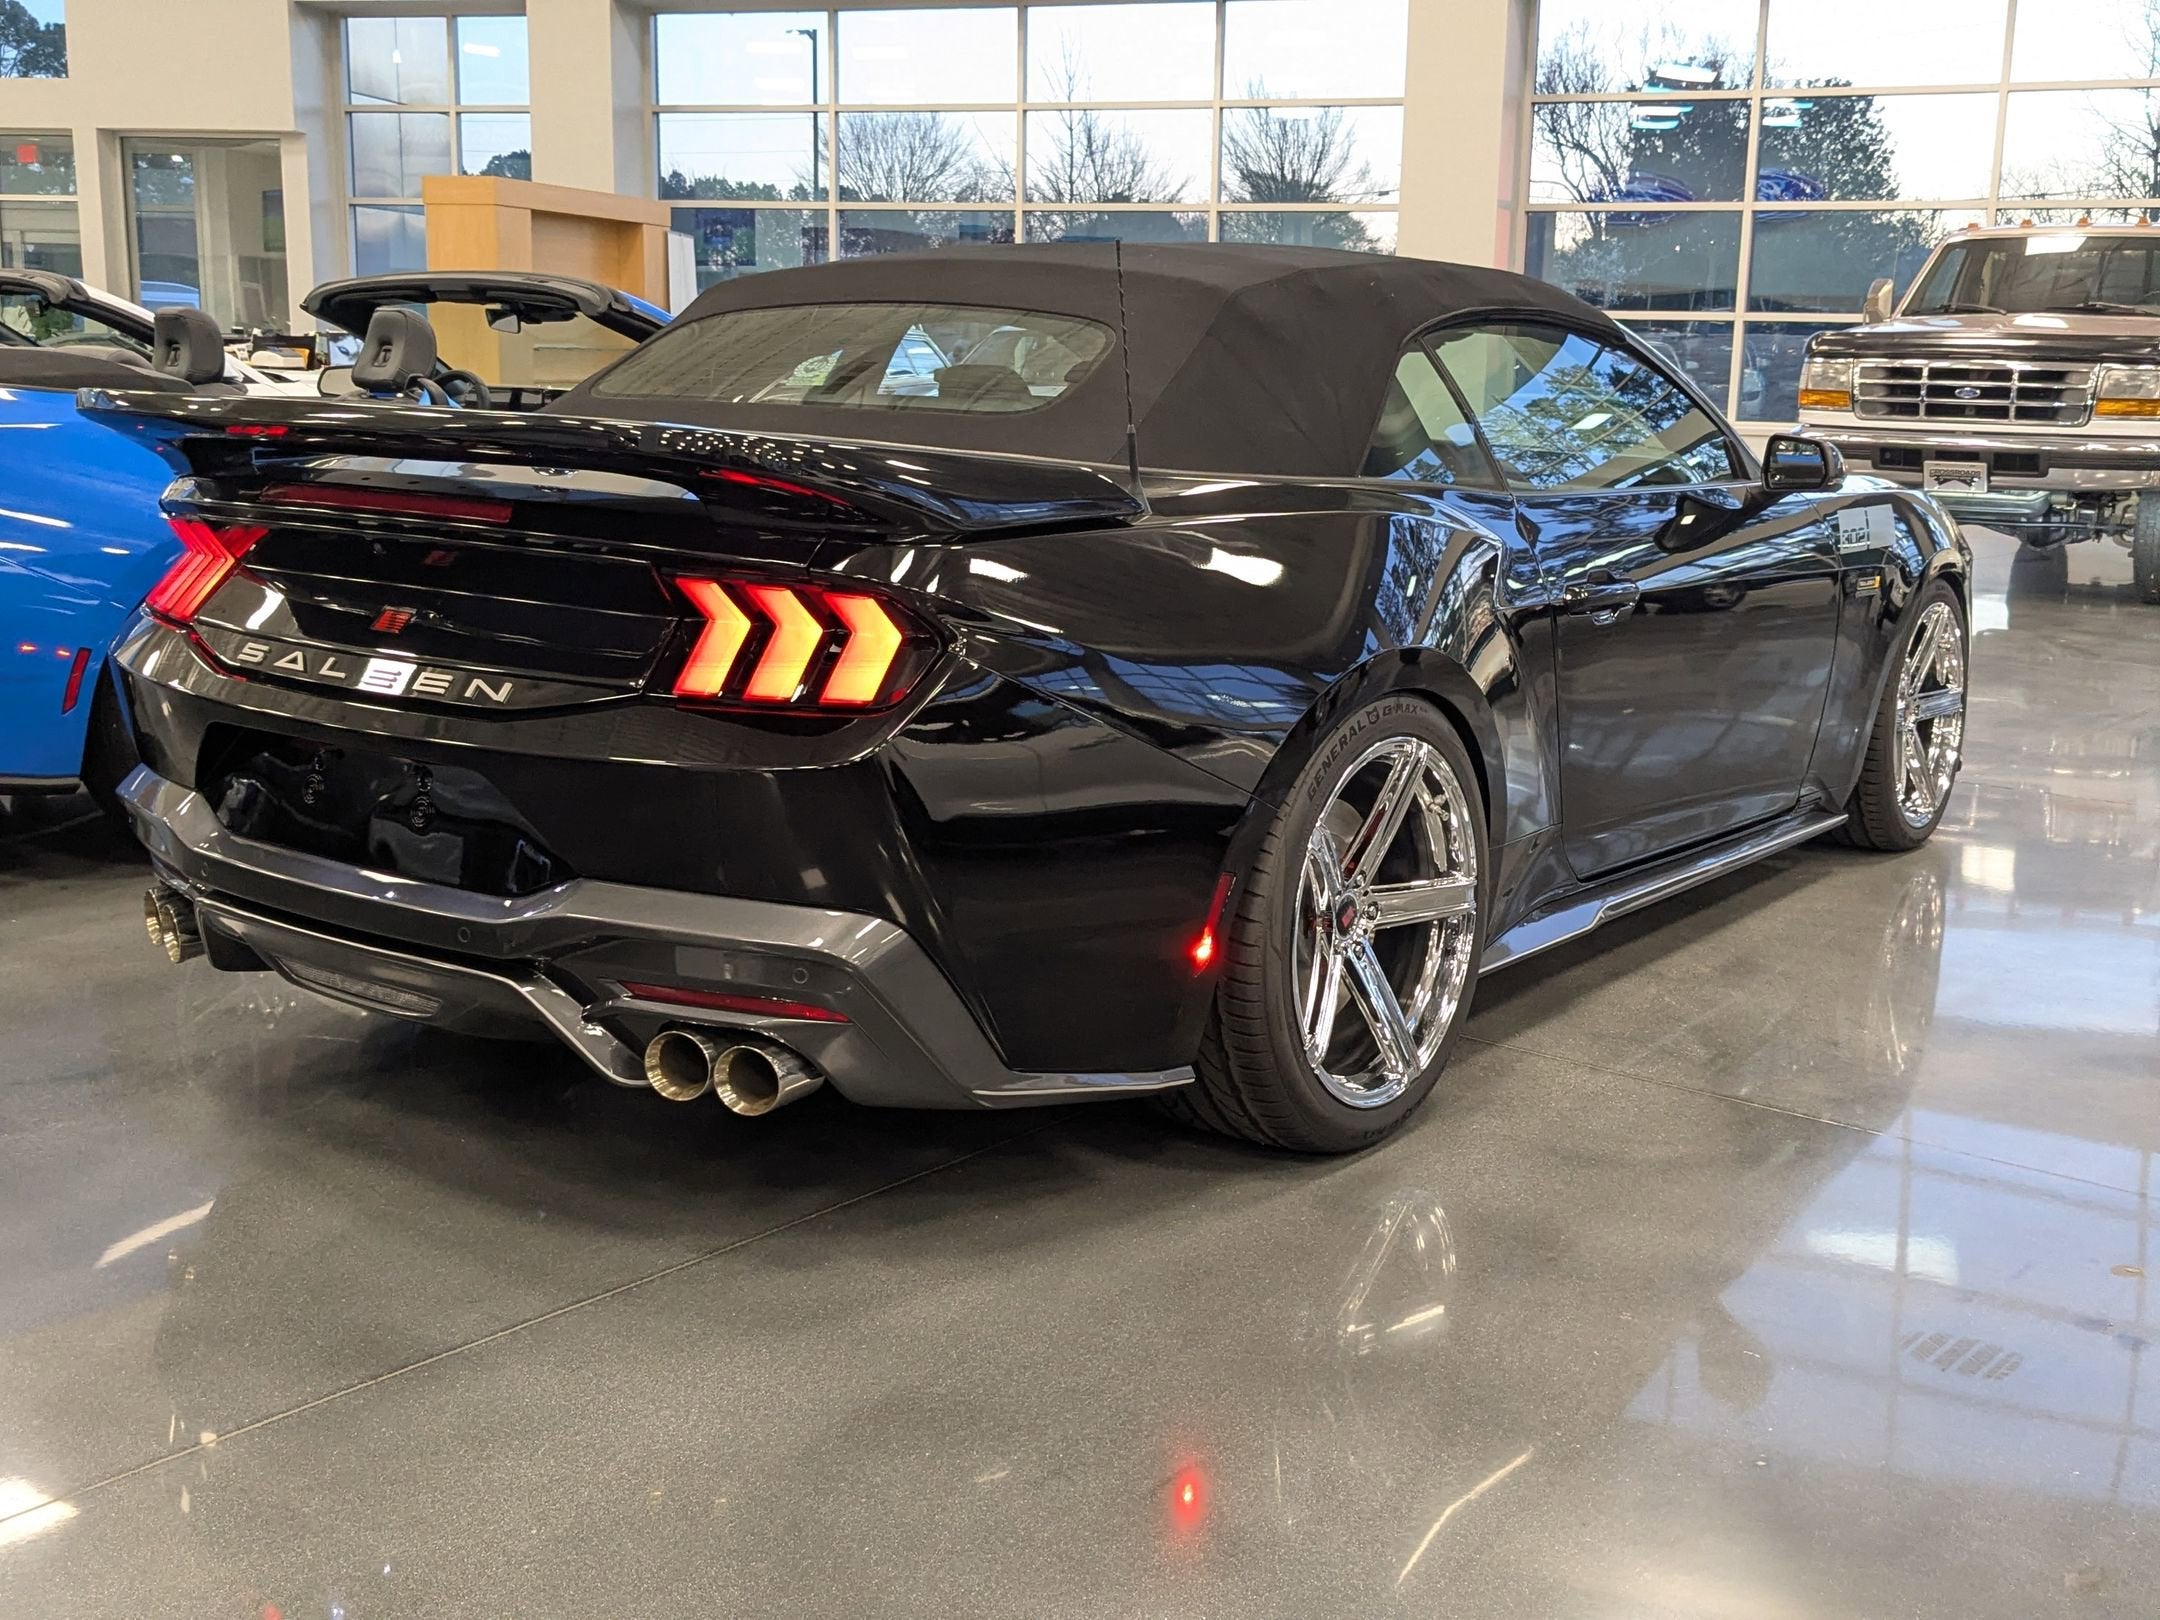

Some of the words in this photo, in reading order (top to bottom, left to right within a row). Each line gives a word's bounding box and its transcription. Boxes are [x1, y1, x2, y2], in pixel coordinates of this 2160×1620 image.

[1929, 468, 1981, 478] CROSSROADS
[237, 642, 513, 704] SALEEN
[1308, 720, 1367, 802] GENERAL
